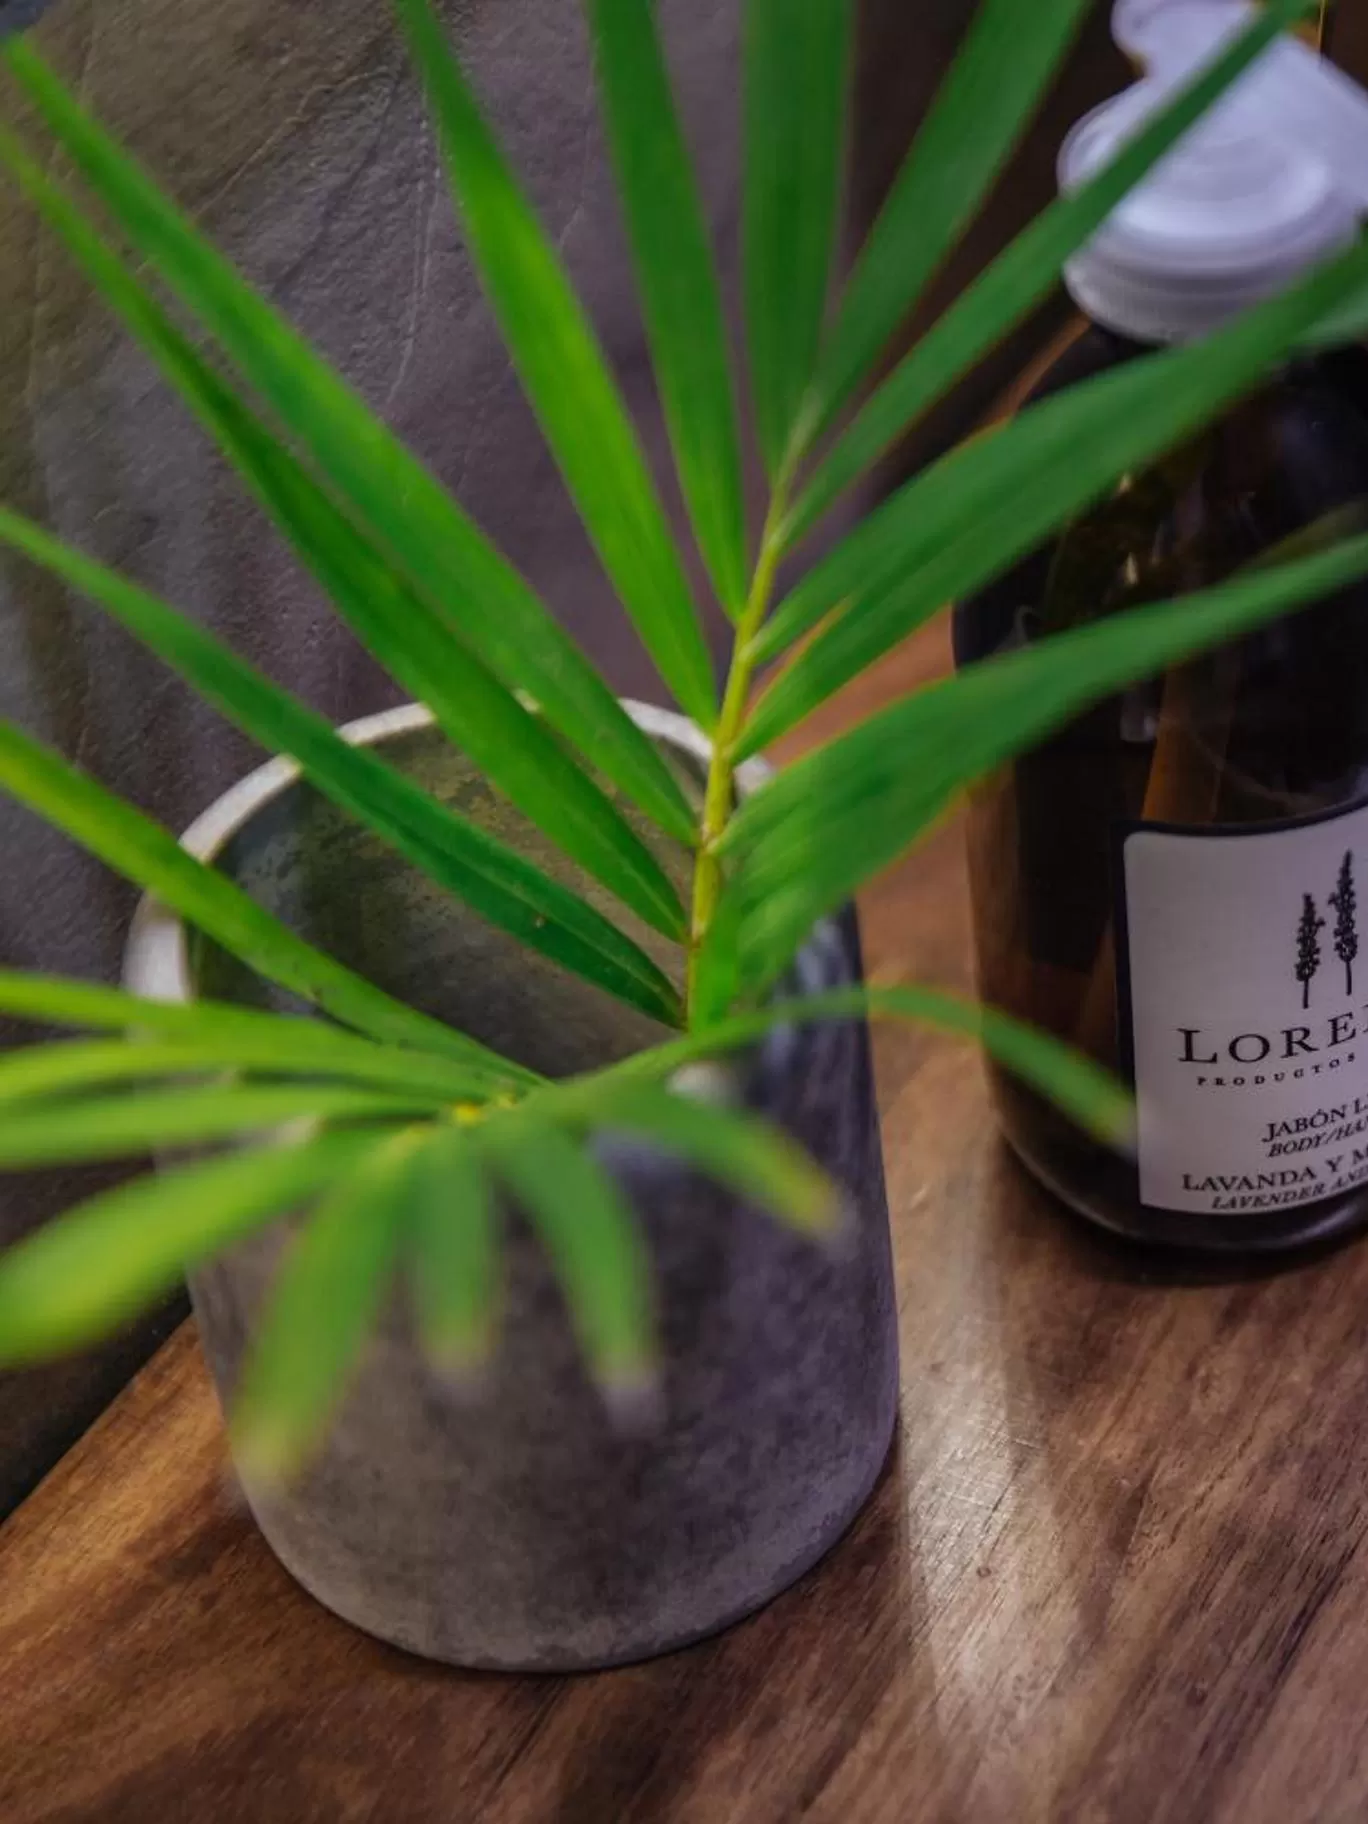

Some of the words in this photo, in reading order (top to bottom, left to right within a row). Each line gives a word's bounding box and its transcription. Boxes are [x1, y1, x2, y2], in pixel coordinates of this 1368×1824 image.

[1197, 1053, 1356, 1087] PRODUCTOS
[1262, 1107, 1349, 1142] JABÓN
[1182, 1165, 1317, 1192] LAVANDA
[1325, 1155, 1344, 1173] Y
[1211, 1183, 1327, 1210] LAVENDER
